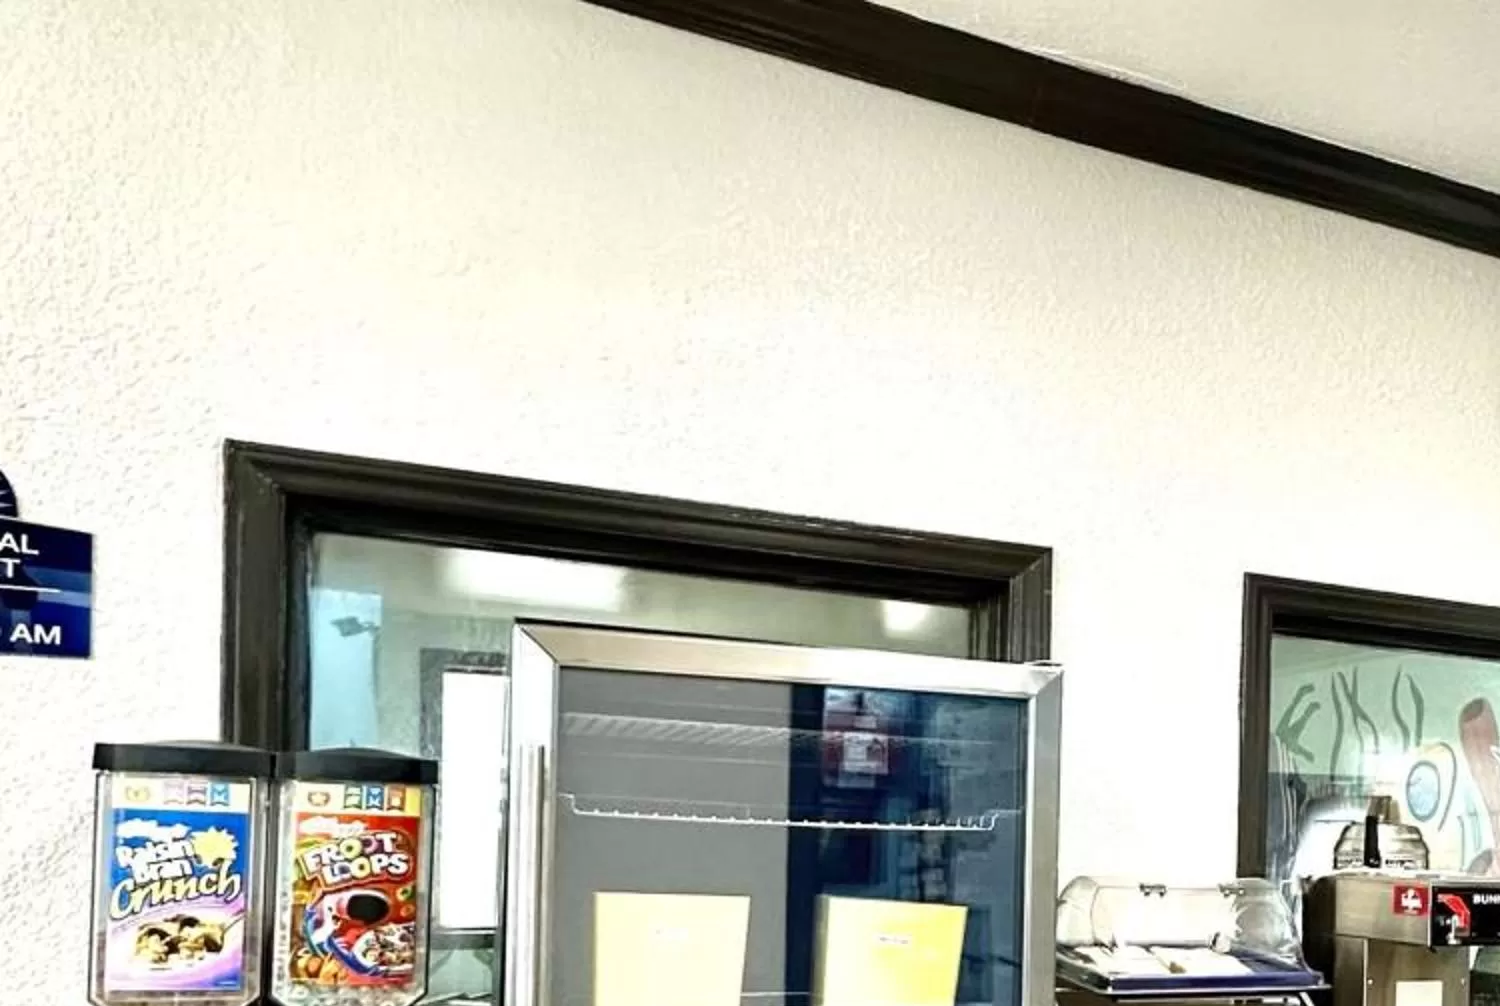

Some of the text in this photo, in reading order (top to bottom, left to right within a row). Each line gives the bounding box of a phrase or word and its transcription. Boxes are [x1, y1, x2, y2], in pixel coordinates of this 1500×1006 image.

[10, 623, 61, 645] AM
[303, 833, 397, 873] FROOT
[322, 854, 409, 885] LOOPS
[110, 858, 242, 920] Crunch
